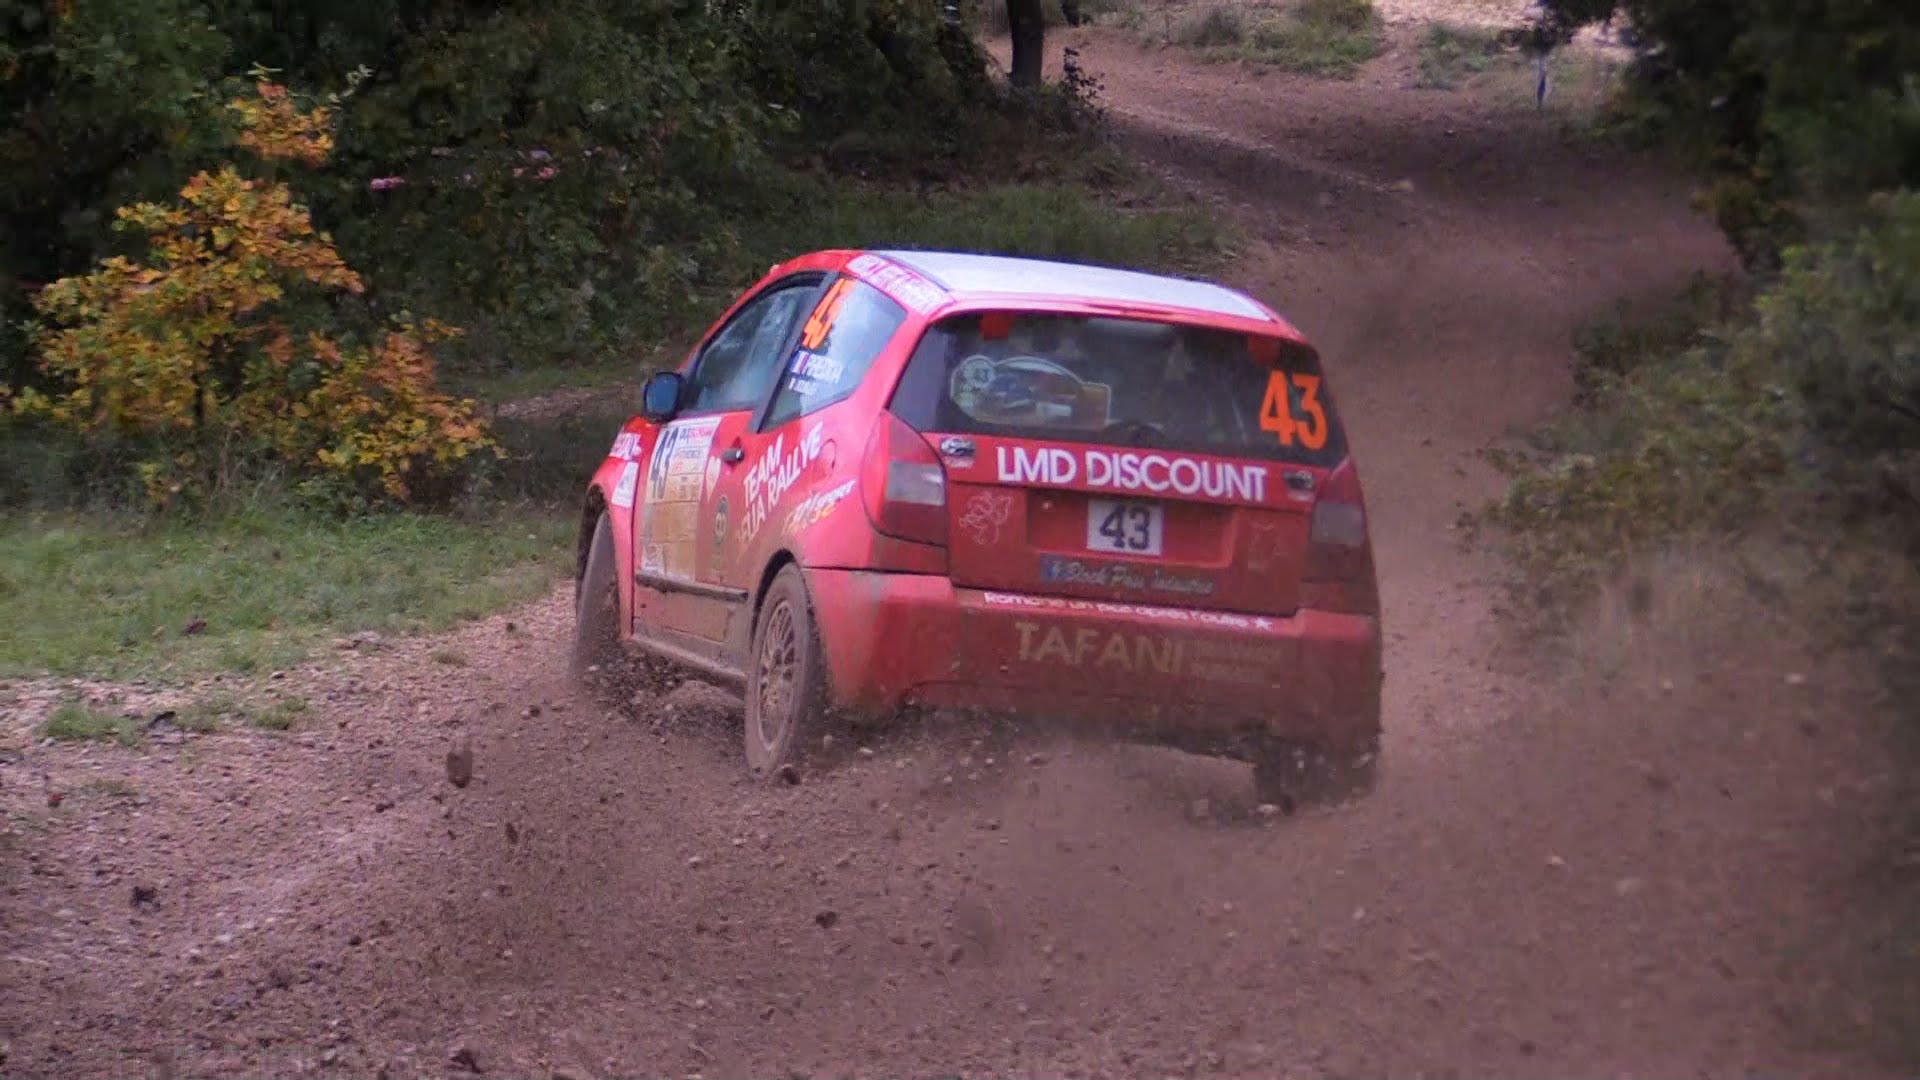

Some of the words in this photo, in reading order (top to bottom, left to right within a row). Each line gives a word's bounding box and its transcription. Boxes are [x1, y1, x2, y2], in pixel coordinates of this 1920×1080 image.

[1259, 369, 1328, 450] 43
[650, 426, 679, 500] 43
[743, 432, 784, 508] TEAM
[768, 421, 824, 513] RALLYE
[996, 446, 1077, 484] LMD
[1084, 450, 1267, 502] DISCOUNT
[1100, 505, 1151, 551] 43
[1015, 620, 1183, 673] TAFANI
